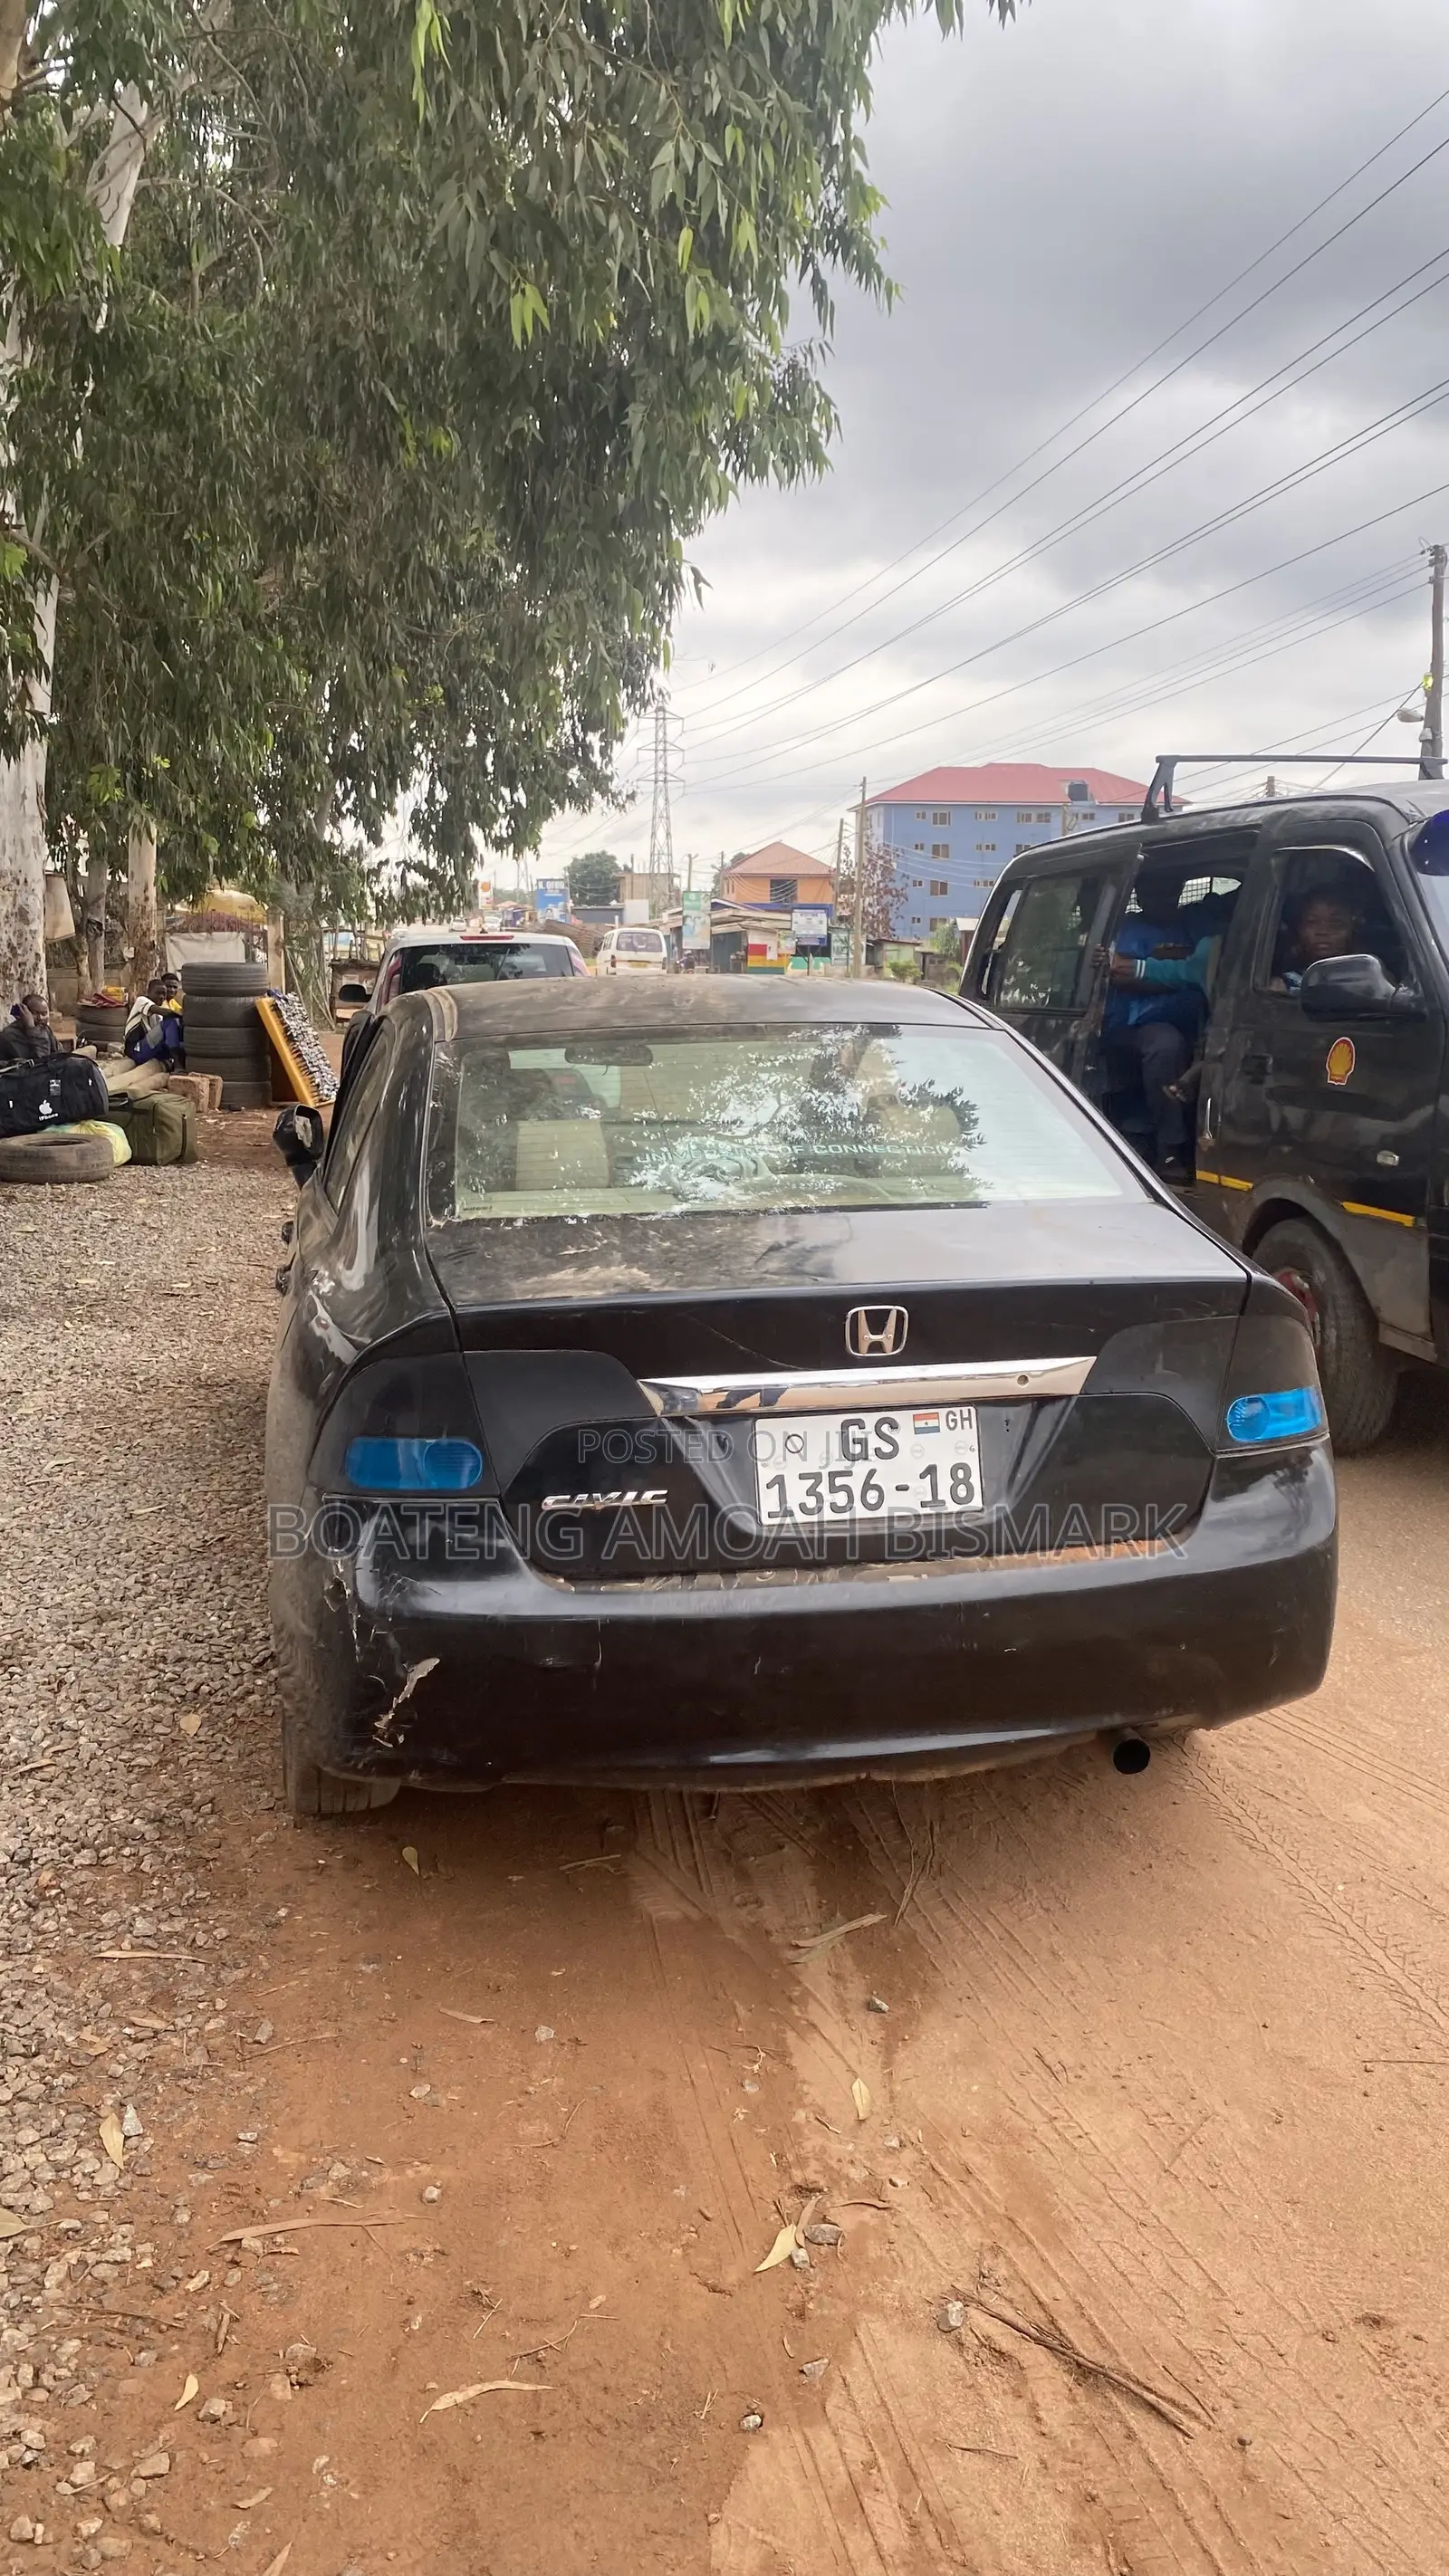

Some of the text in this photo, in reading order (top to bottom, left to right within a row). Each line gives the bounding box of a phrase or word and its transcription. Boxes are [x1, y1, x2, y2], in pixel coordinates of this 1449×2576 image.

[779, 1145, 805, 1155] OF
[945, 1408, 974, 1432] GH
[840, 1416, 900, 1461] GS
[541, 1489, 668, 1510] CIVIC
[766, 1461, 974, 1519] 1356-18
